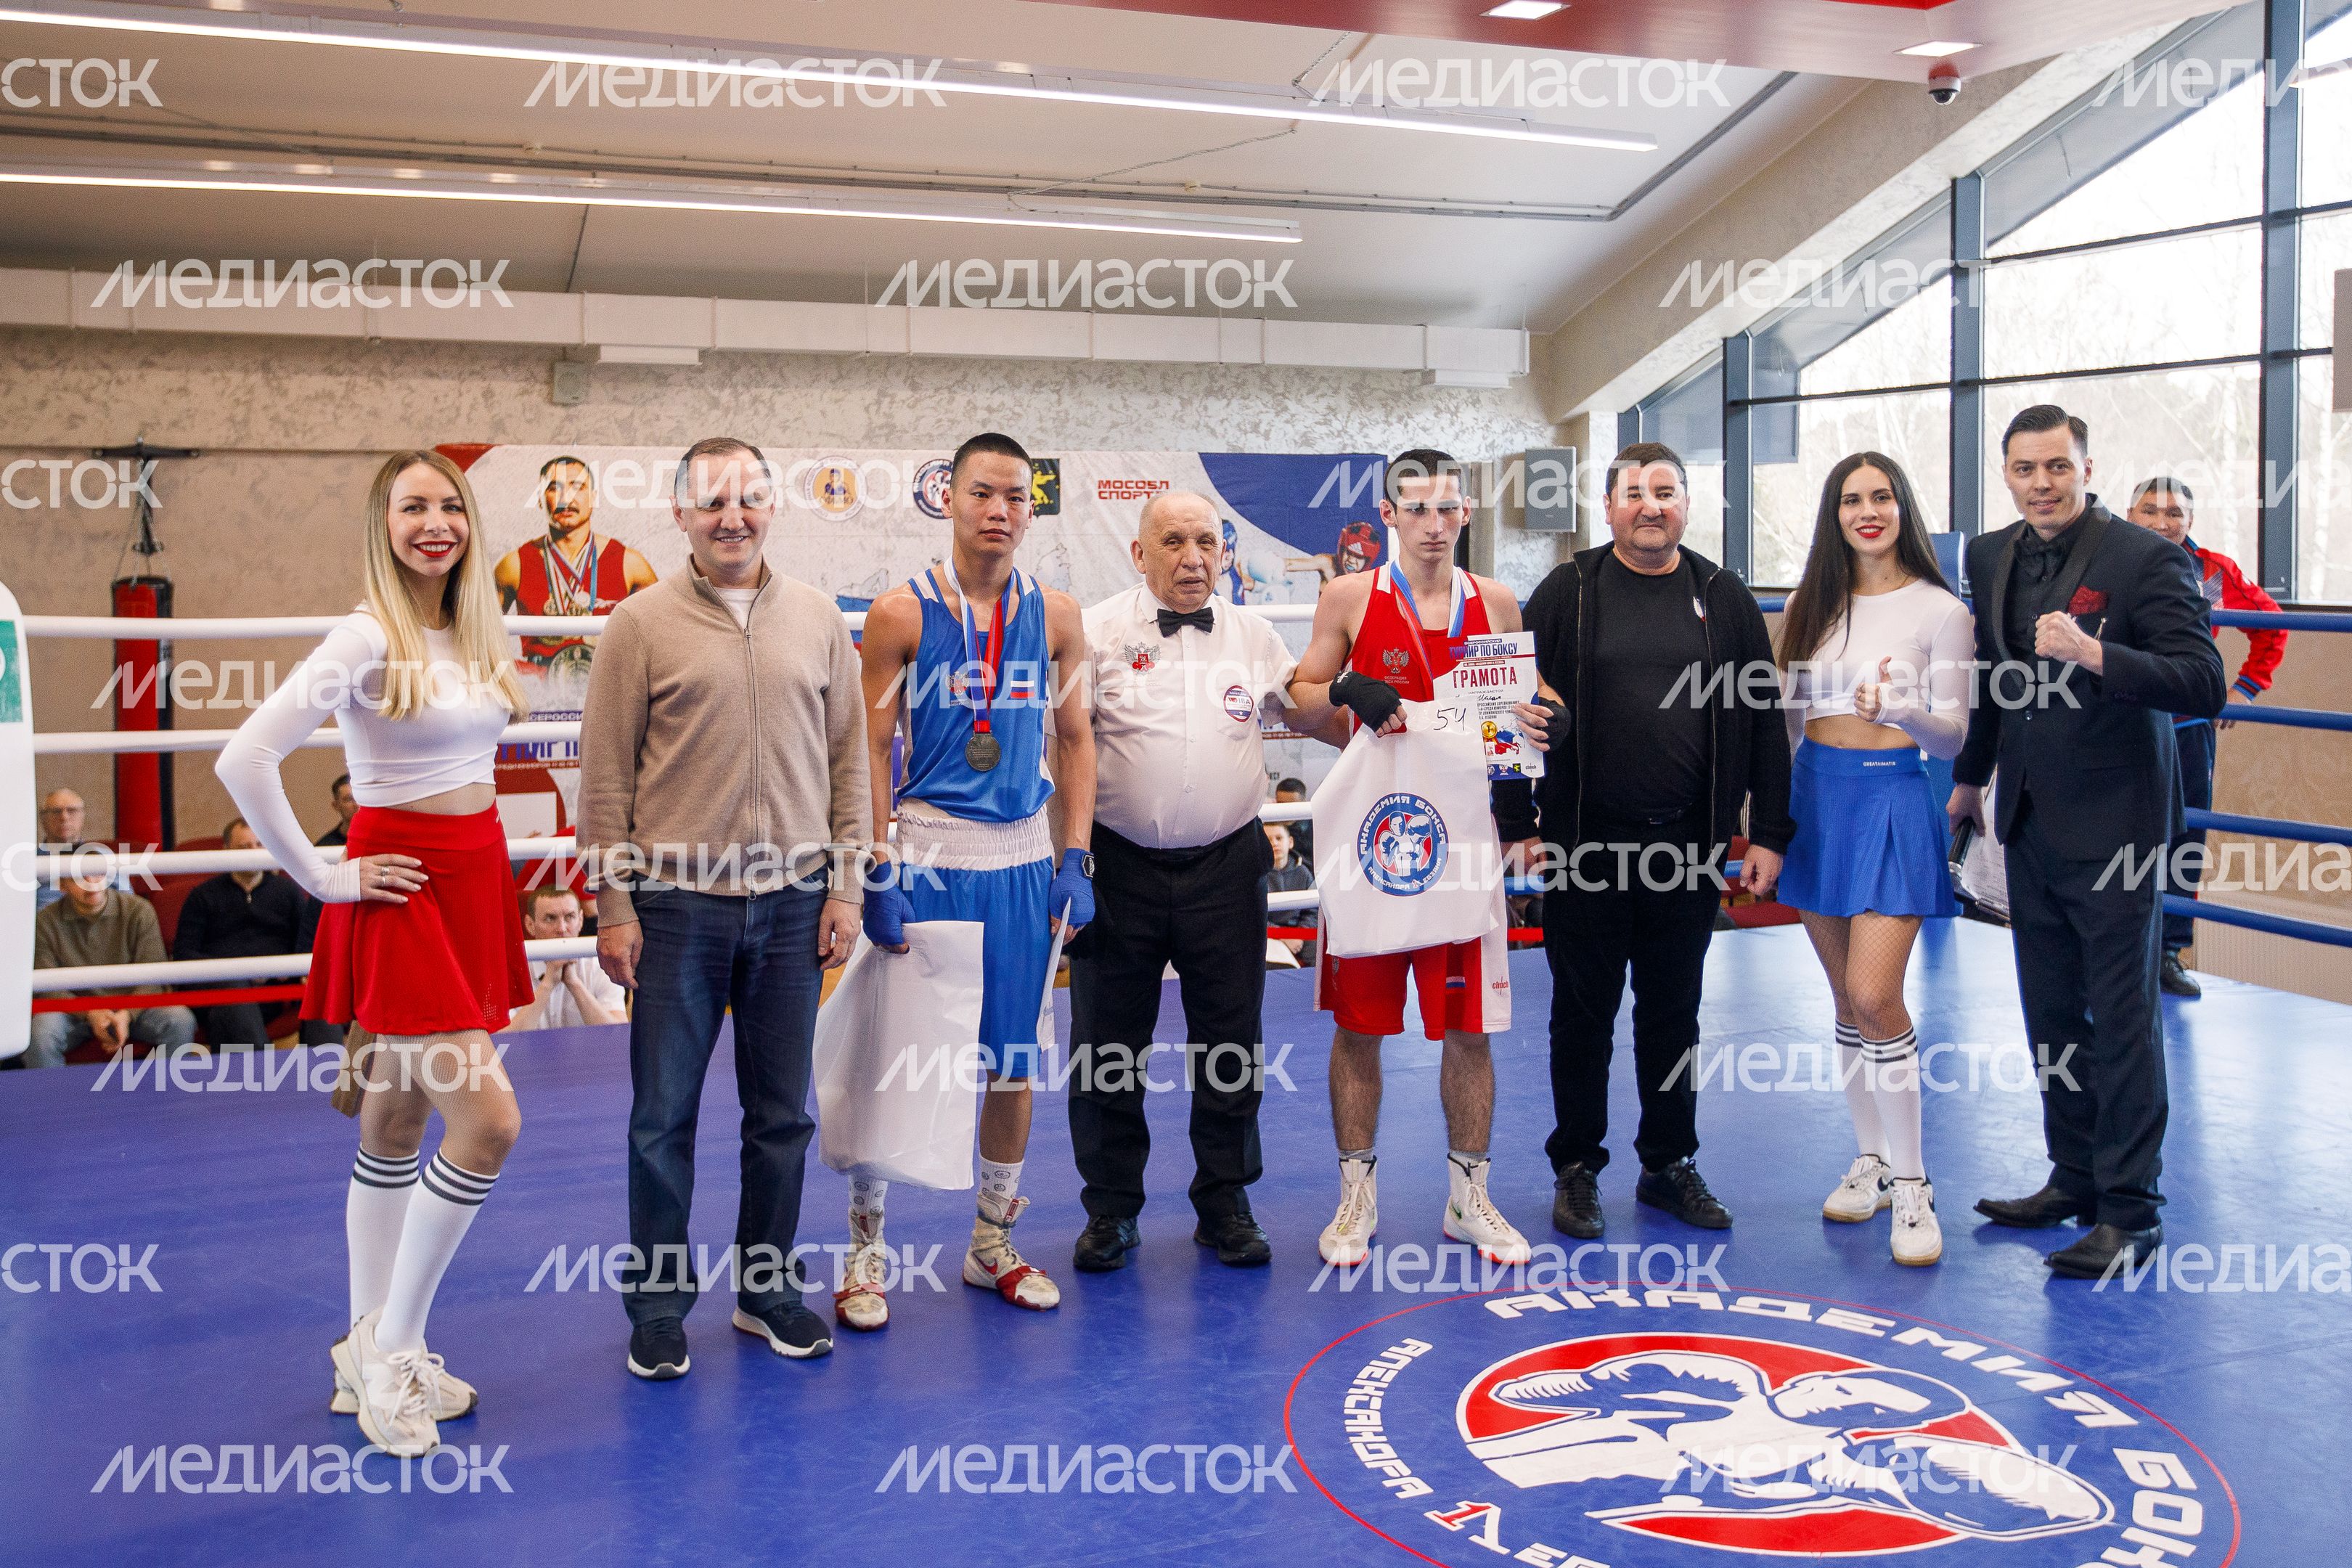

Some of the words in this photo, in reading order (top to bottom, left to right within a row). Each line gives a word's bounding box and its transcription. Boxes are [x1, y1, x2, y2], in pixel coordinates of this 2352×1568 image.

[1098, 491, 1163, 499] СПОРТ
[1481, 643, 1490, 657] ПО
[1493, 642, 1518, 656] БОКСУ
[1453, 666, 1518, 688] ГРАМОТА
[1433, 707, 1466, 731] 54
[1360, 796, 1410, 855] АКАДЕМИЯ
[1415, 799, 1446, 845] БОКСА
[1485, 1290, 2139, 1429] АКАДЕМИЯ
[2075, 1447, 2203, 1568] БОК
